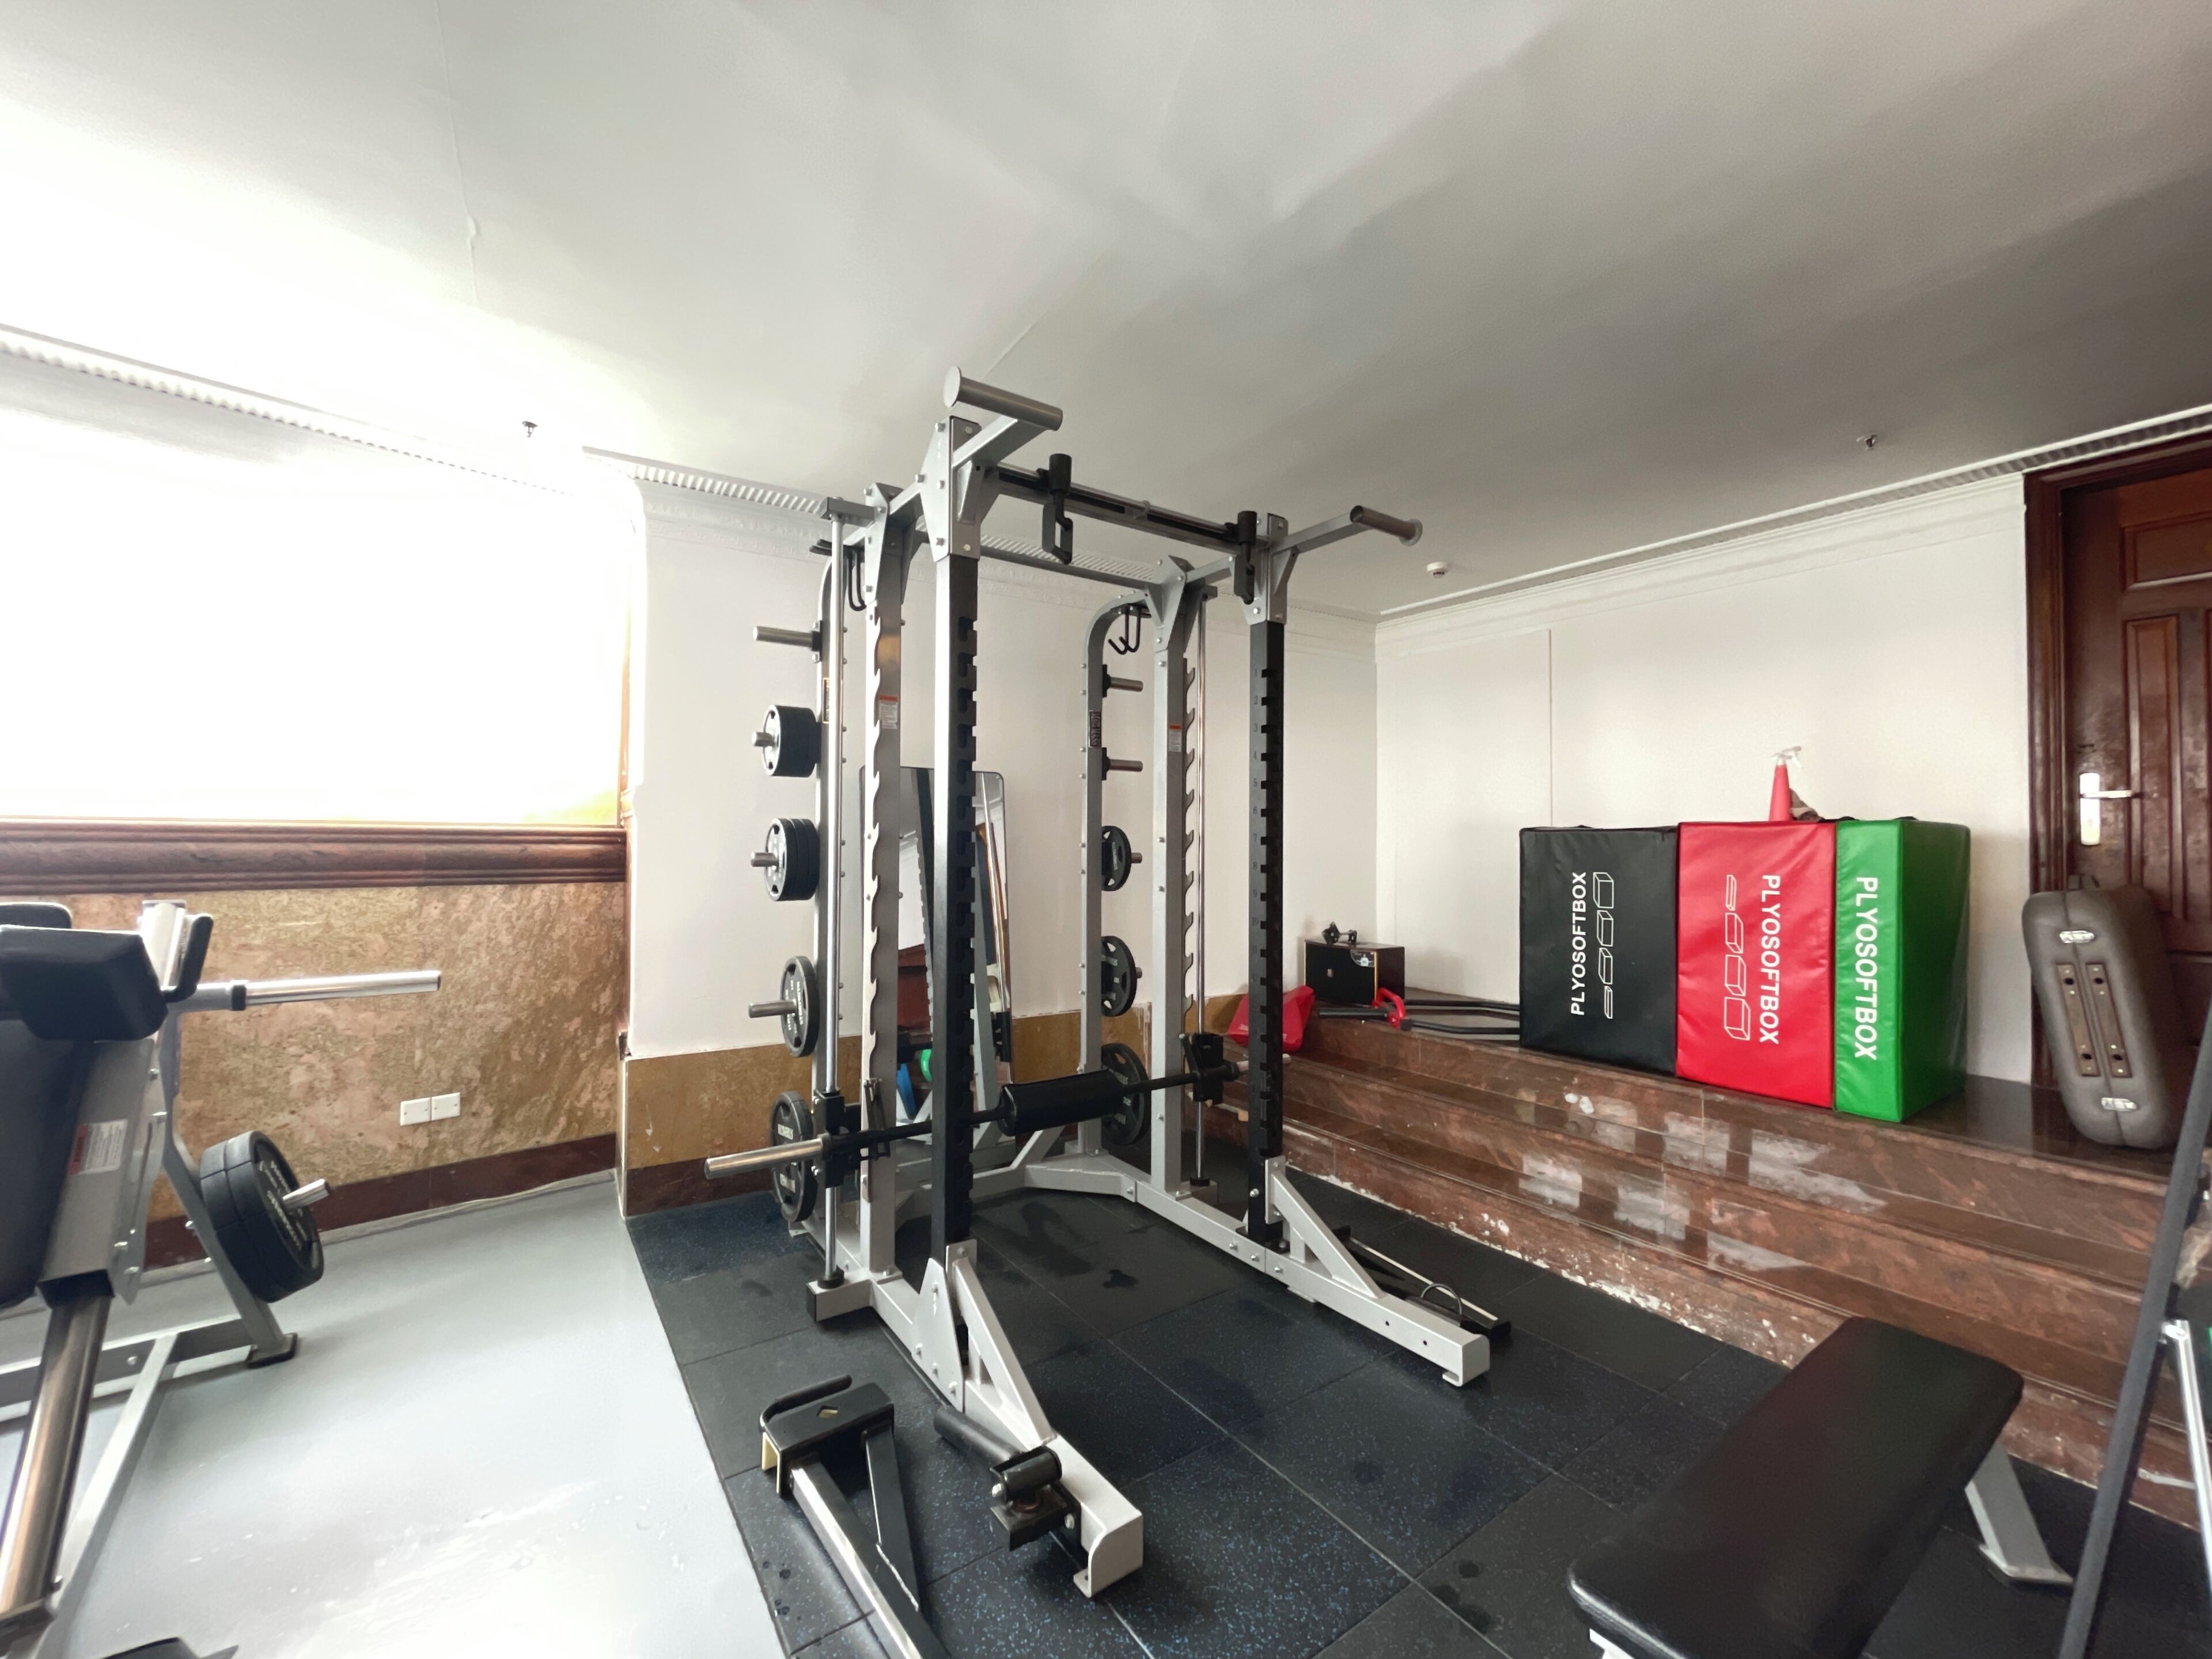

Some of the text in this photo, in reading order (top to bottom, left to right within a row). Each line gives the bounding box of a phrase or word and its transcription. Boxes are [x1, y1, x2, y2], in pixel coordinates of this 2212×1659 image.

[1570, 872, 1586, 1016] PLYOSOFTBOX
[1759, 875, 1781, 1044] PLYOSOFTBOX
[1854, 877, 1878, 1060] PLYOSOFTBOX
